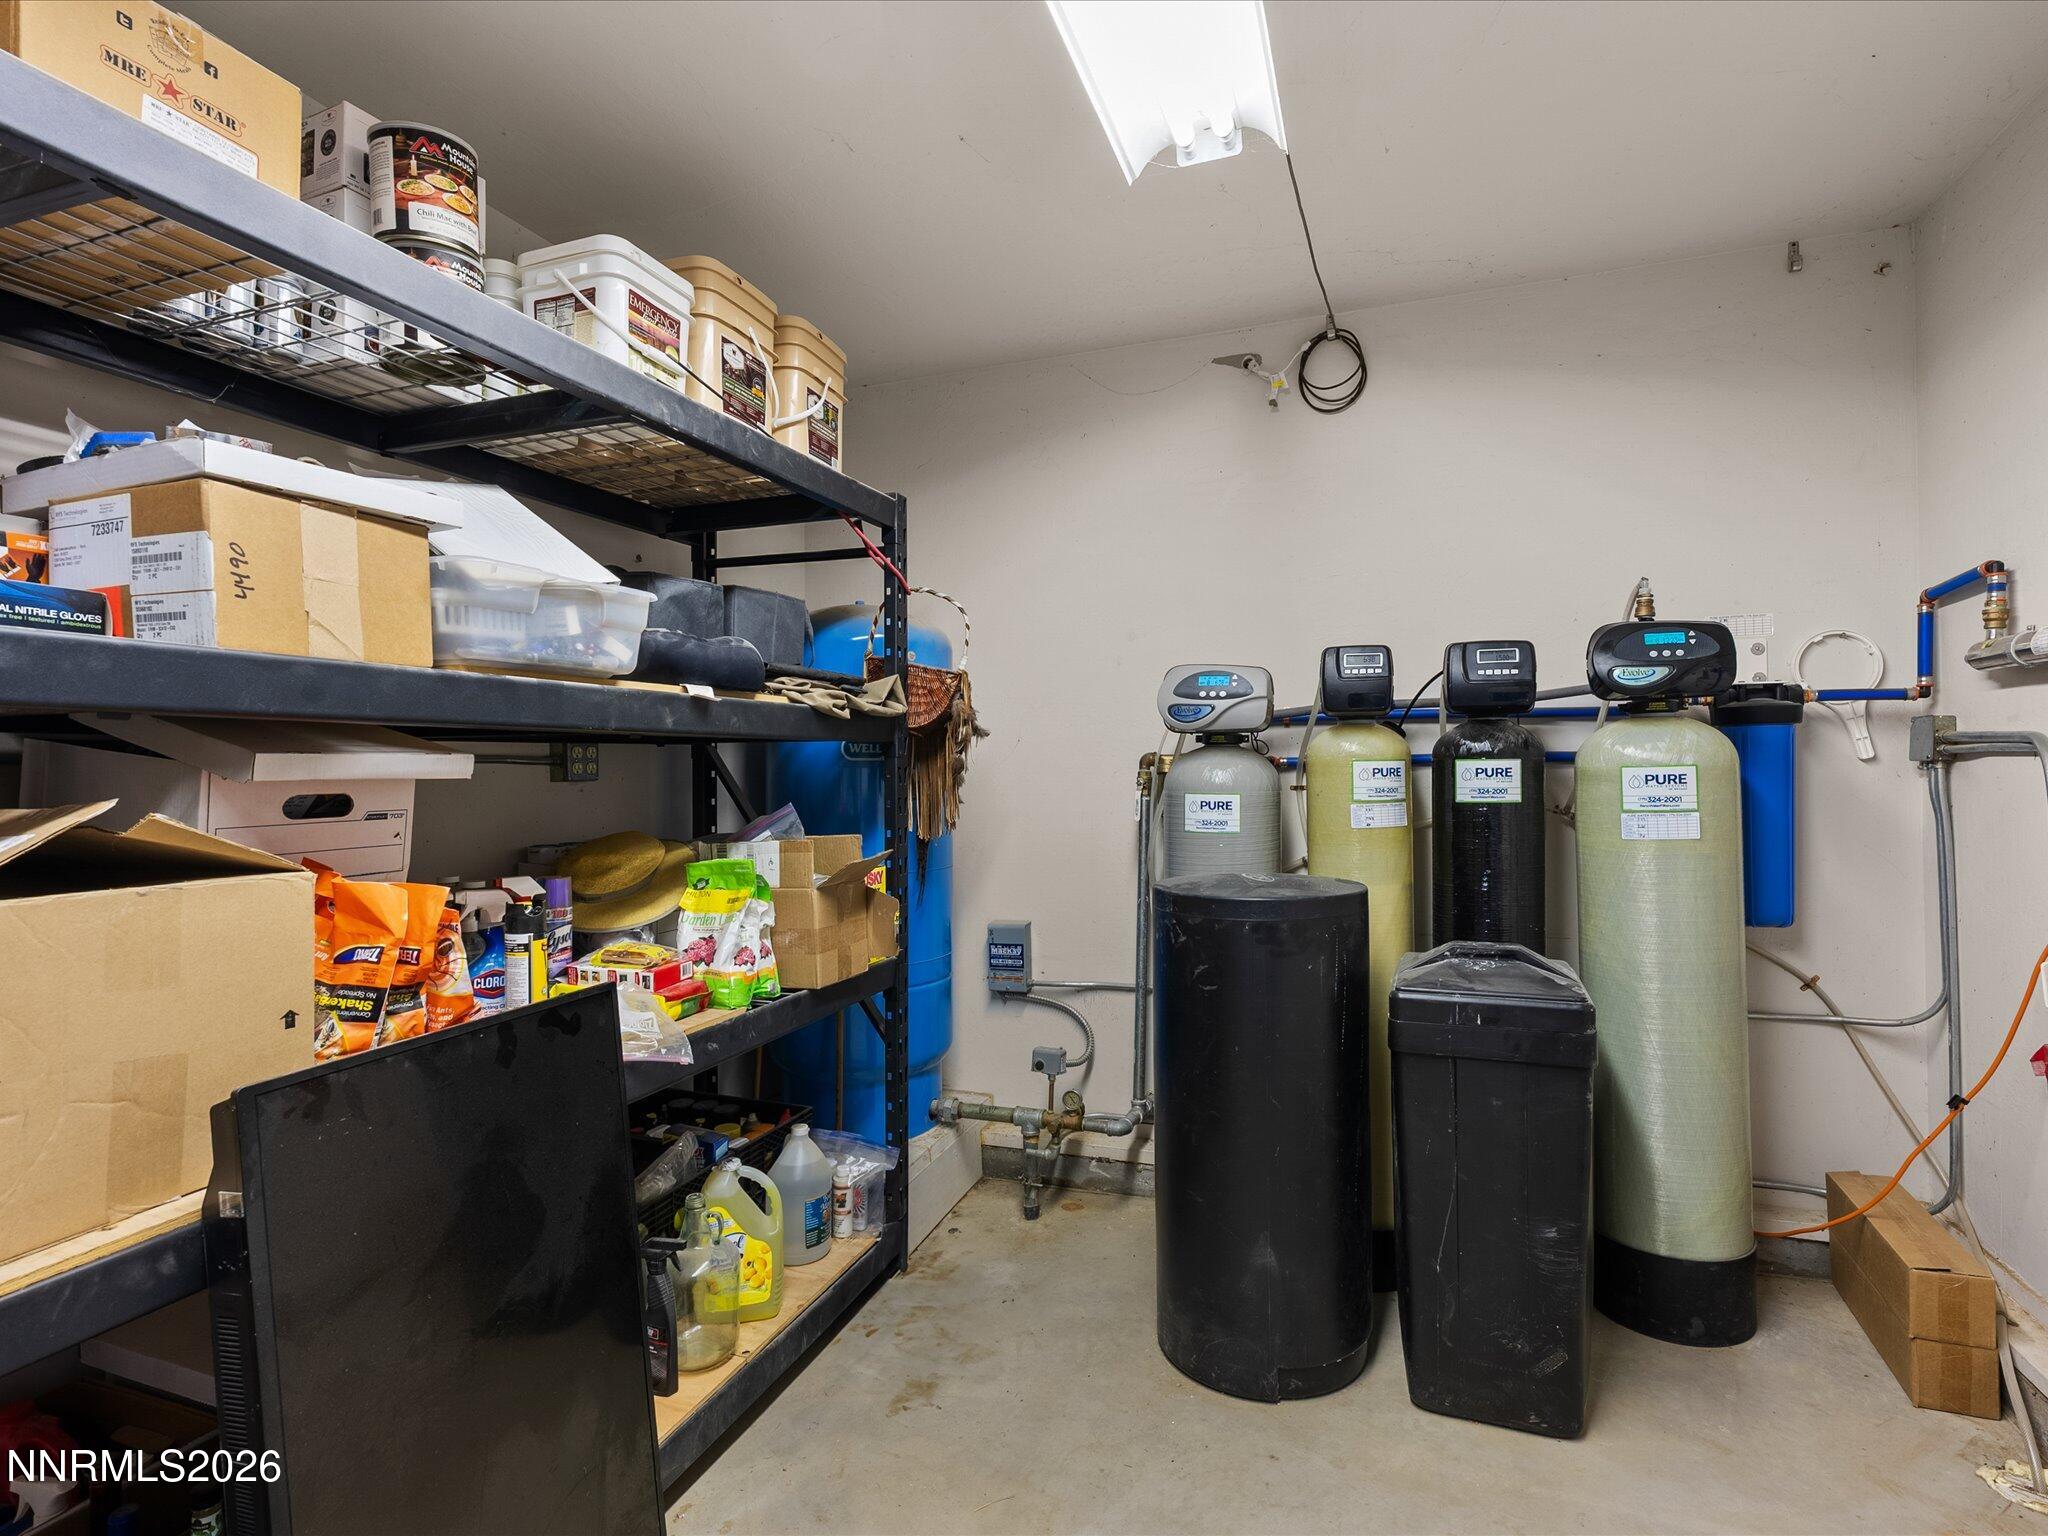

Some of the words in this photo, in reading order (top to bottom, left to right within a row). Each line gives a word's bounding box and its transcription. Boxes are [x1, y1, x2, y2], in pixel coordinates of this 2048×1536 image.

[104, 49, 147, 82] MRE
[192, 98, 238, 131] STAR
[449, 154, 475, 175] House
[417, 207, 435, 220] Chili
[436, 211, 452, 223] Mac
[453, 218, 467, 229] with
[629, 294, 680, 333] EMERGENCY
[91, 520, 124, 536] 7233747
[229, 542, 255, 599] 4490
[15, 605, 58, 618] NITRILE
[60, 611, 102, 624] GLOVES
[28, 616, 56, 624] textured
[60, 620, 101, 629] ambidextrous
[1622, 669, 1650, 677] Evolve
[848, 743, 882, 753] WELL
[1372, 768, 1402, 778] PURE
[1476, 768, 1512, 778] PURE
[1645, 774, 1688, 784] PURE
[1200, 801, 1232, 810] PURE
[866, 870, 884, 886] SKY
[680, 914, 717, 927] Garden
